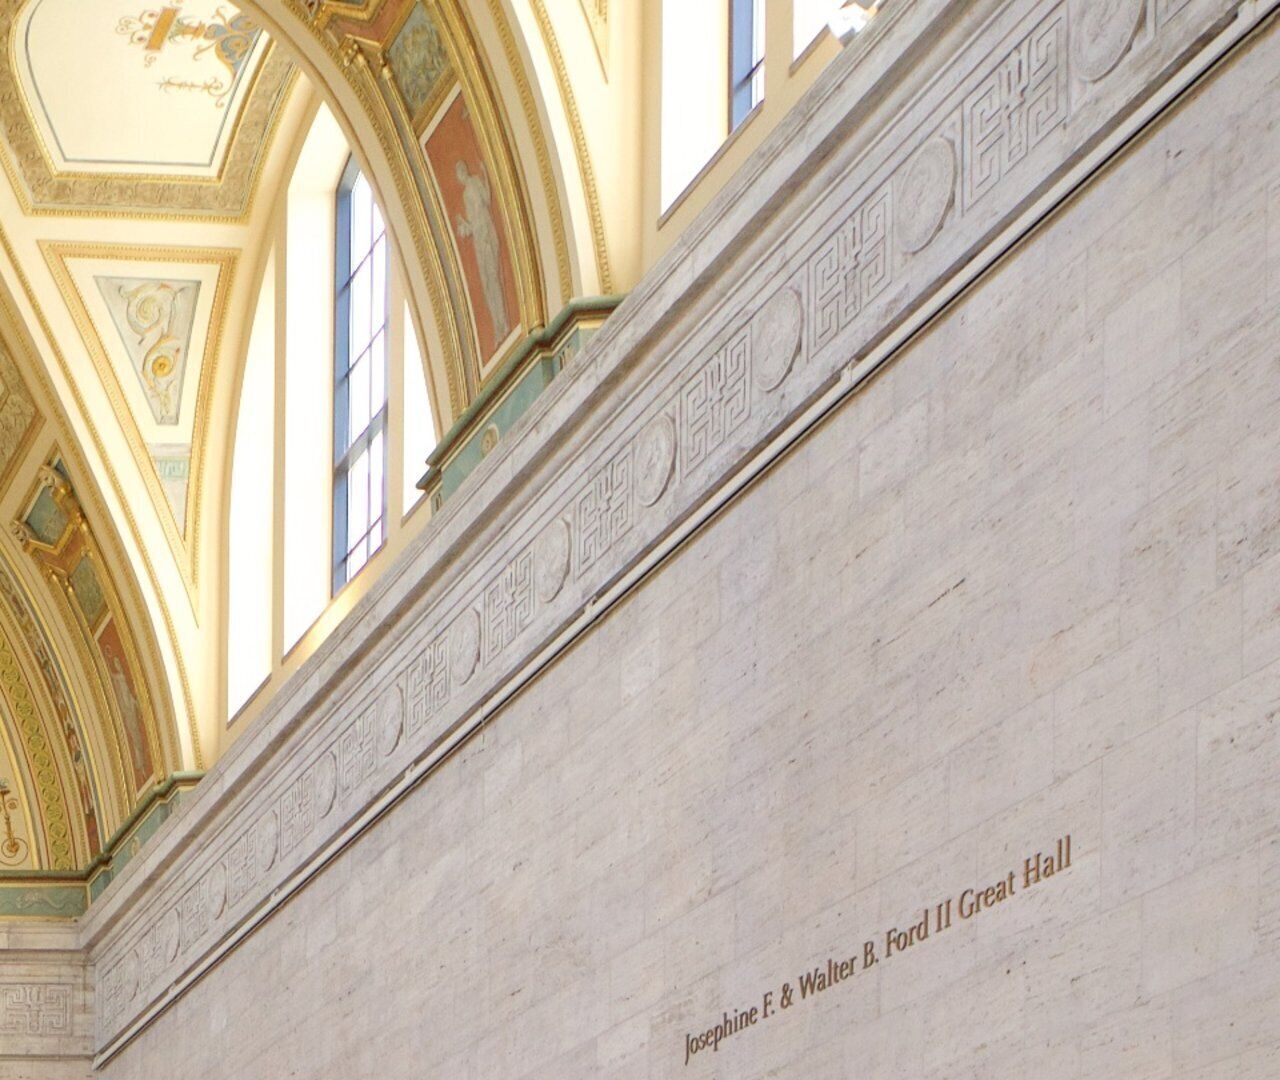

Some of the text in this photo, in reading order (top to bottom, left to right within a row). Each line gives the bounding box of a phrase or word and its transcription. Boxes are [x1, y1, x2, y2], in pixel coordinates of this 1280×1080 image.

[684, 834, 1073, 1065] Josephine F. & Walter B. Ford II Great Hall
